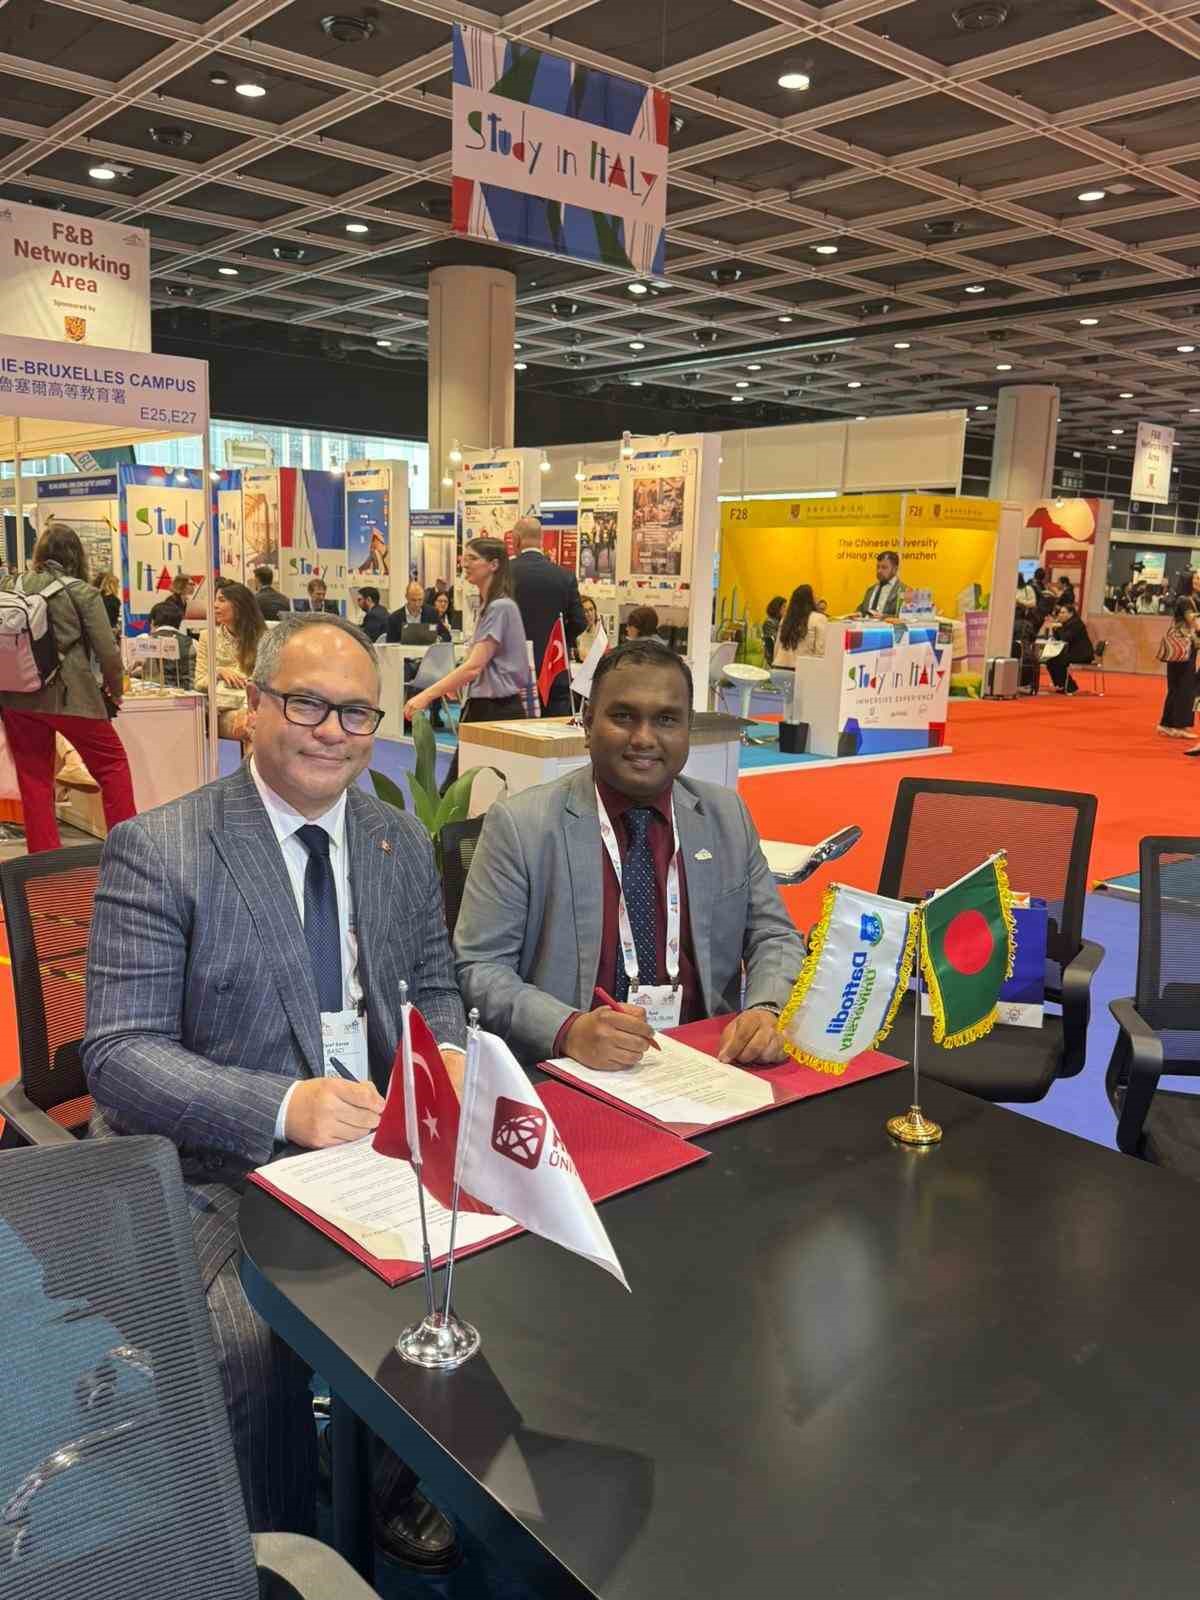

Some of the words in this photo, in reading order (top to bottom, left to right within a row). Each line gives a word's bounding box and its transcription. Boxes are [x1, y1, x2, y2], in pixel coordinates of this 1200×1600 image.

[52, 222, 93, 246] F&B
[14, 238, 130, 280] Networking
[51, 270, 97, 293] Area
[1, 358, 125, 385] IE-BRUXELLES
[129, 373, 196, 393] CAMPUS
[140, 407, 197, 425] E25,E27
[730, 508, 748, 521] F28
[855, 539, 889, 548] Chinese
